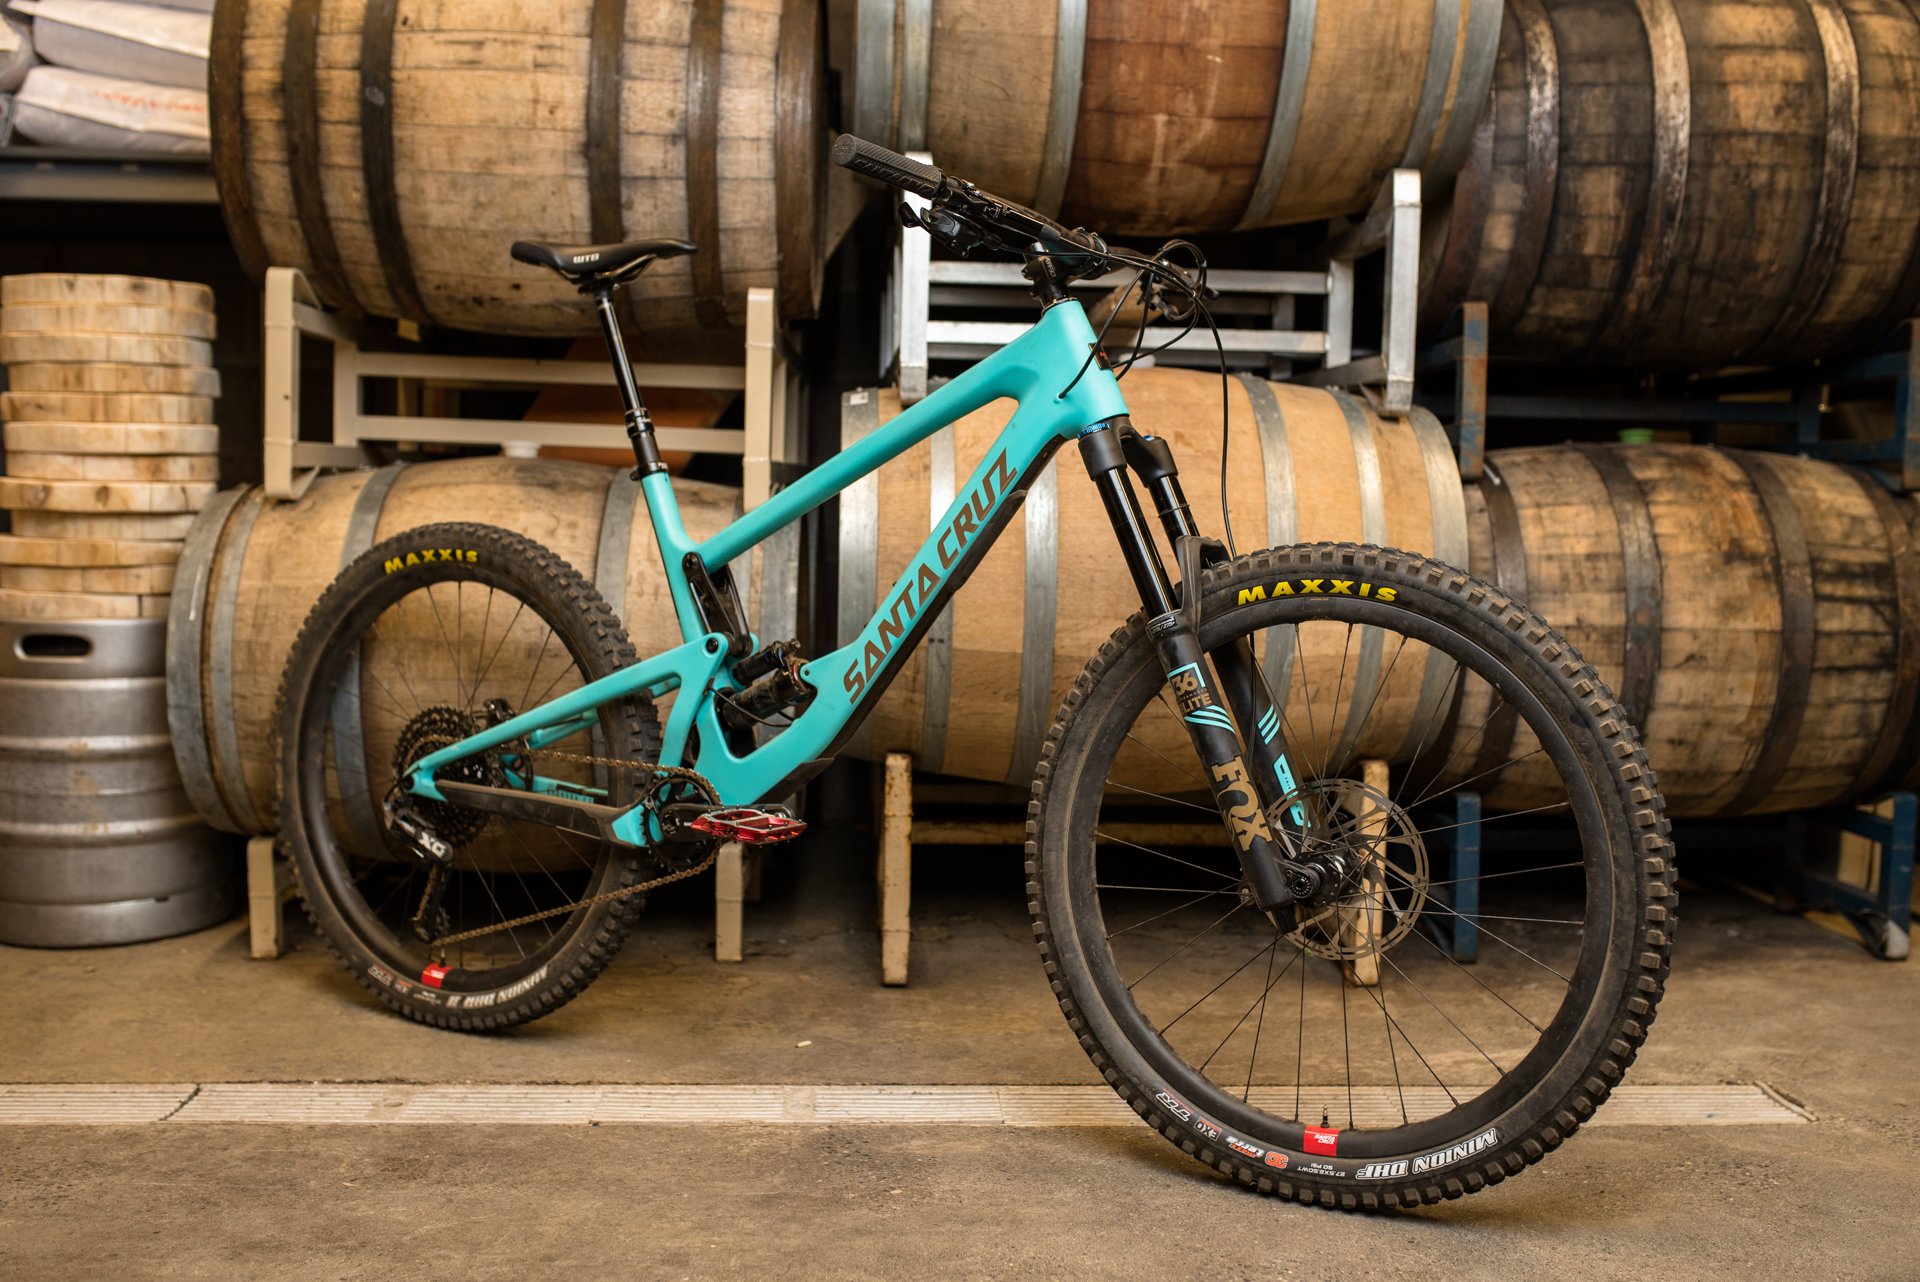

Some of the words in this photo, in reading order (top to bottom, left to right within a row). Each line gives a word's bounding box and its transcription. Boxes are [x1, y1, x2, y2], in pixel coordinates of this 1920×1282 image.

[384, 548, 478, 575] MAXXIS
[843, 563, 941, 704] SANTA
[937, 447, 1018, 570] CRUZ
[1237, 579, 1398, 606] MAXXIS
[1171, 671, 1198, 697] 36
[1181, 692, 1212, 714] LITE
[1211, 755, 1273, 852] FOX
[1156, 1091, 1191, 1122] TR
[1195, 1121, 1218, 1141] EXO
[1265, 1151, 1289, 1169] 3C
[1412, 1128, 1499, 1174] MINION
[1355, 1159, 1409, 1180] DHF
